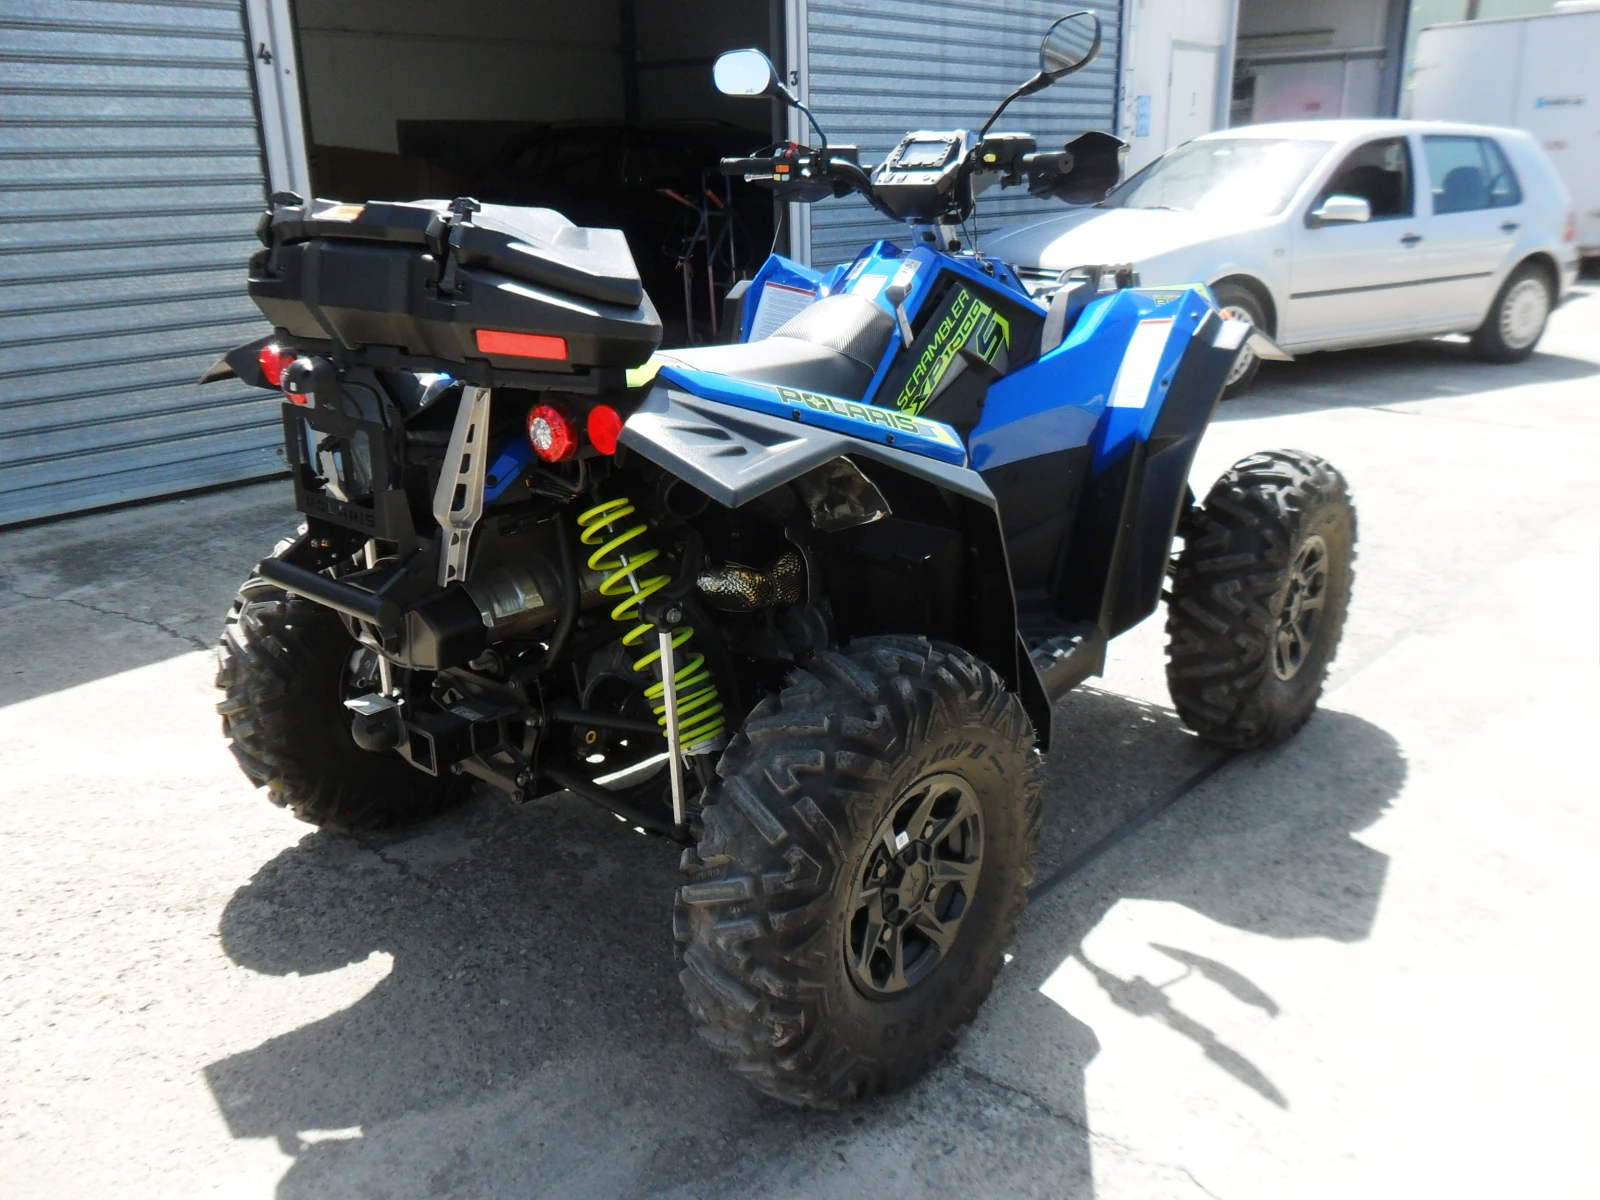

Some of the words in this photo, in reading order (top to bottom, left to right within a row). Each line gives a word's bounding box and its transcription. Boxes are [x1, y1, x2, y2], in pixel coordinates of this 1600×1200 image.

[790, 70, 799, 86] 3
[896, 288, 970, 410] SCRAMBLER
[775, 386, 921, 435] POLARIS
[306, 496, 376, 528] POLARIS
